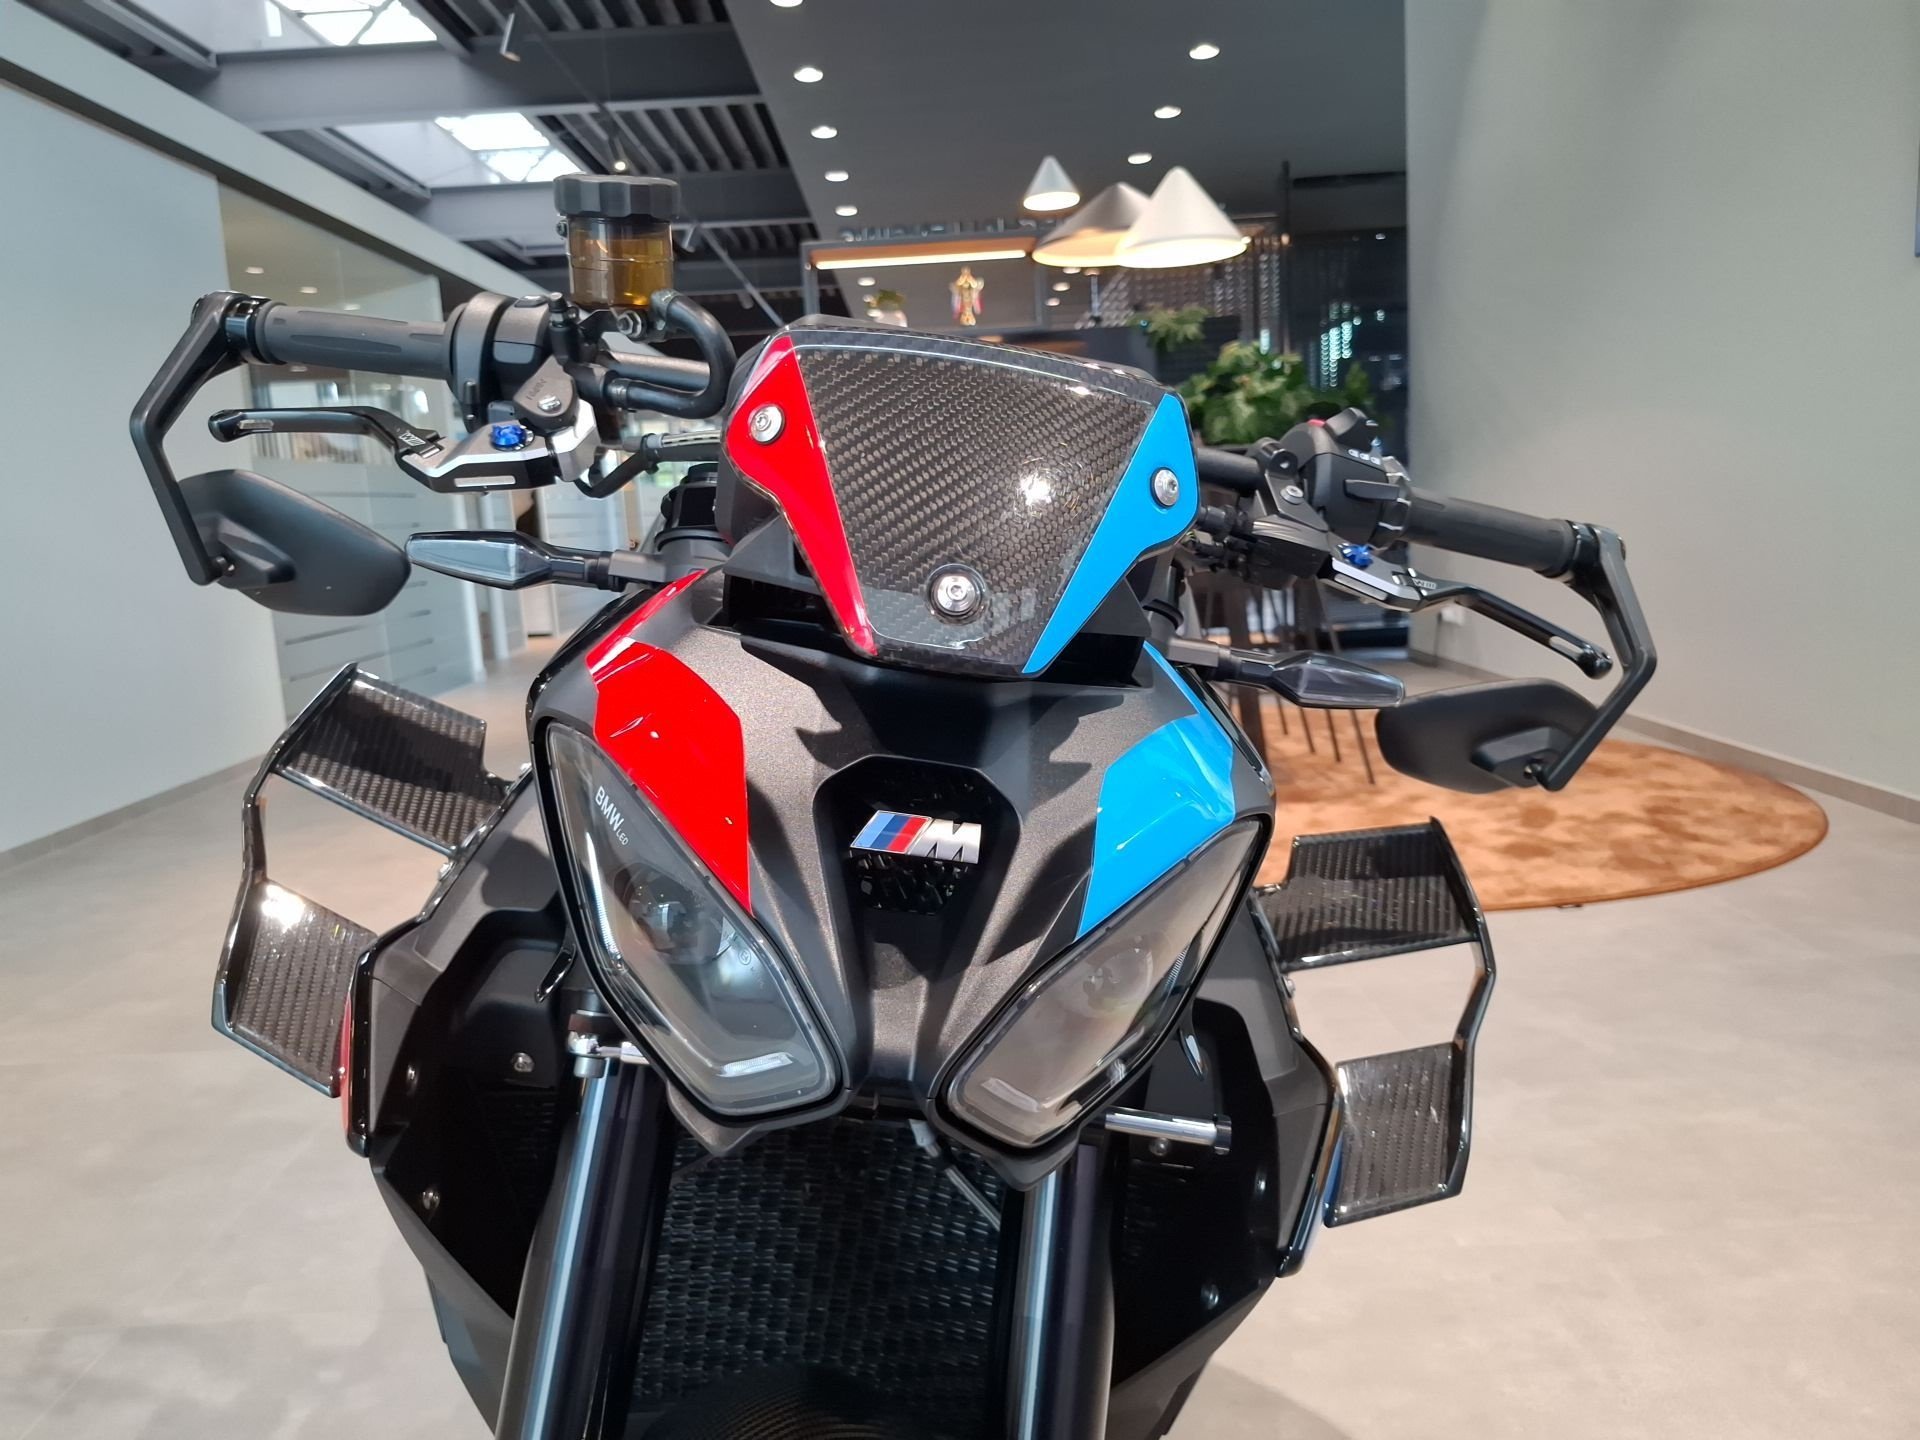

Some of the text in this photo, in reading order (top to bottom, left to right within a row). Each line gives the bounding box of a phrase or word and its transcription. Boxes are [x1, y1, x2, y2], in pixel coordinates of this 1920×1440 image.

[595, 786, 629, 845] BMW LED
[908, 818, 982, 864] M
